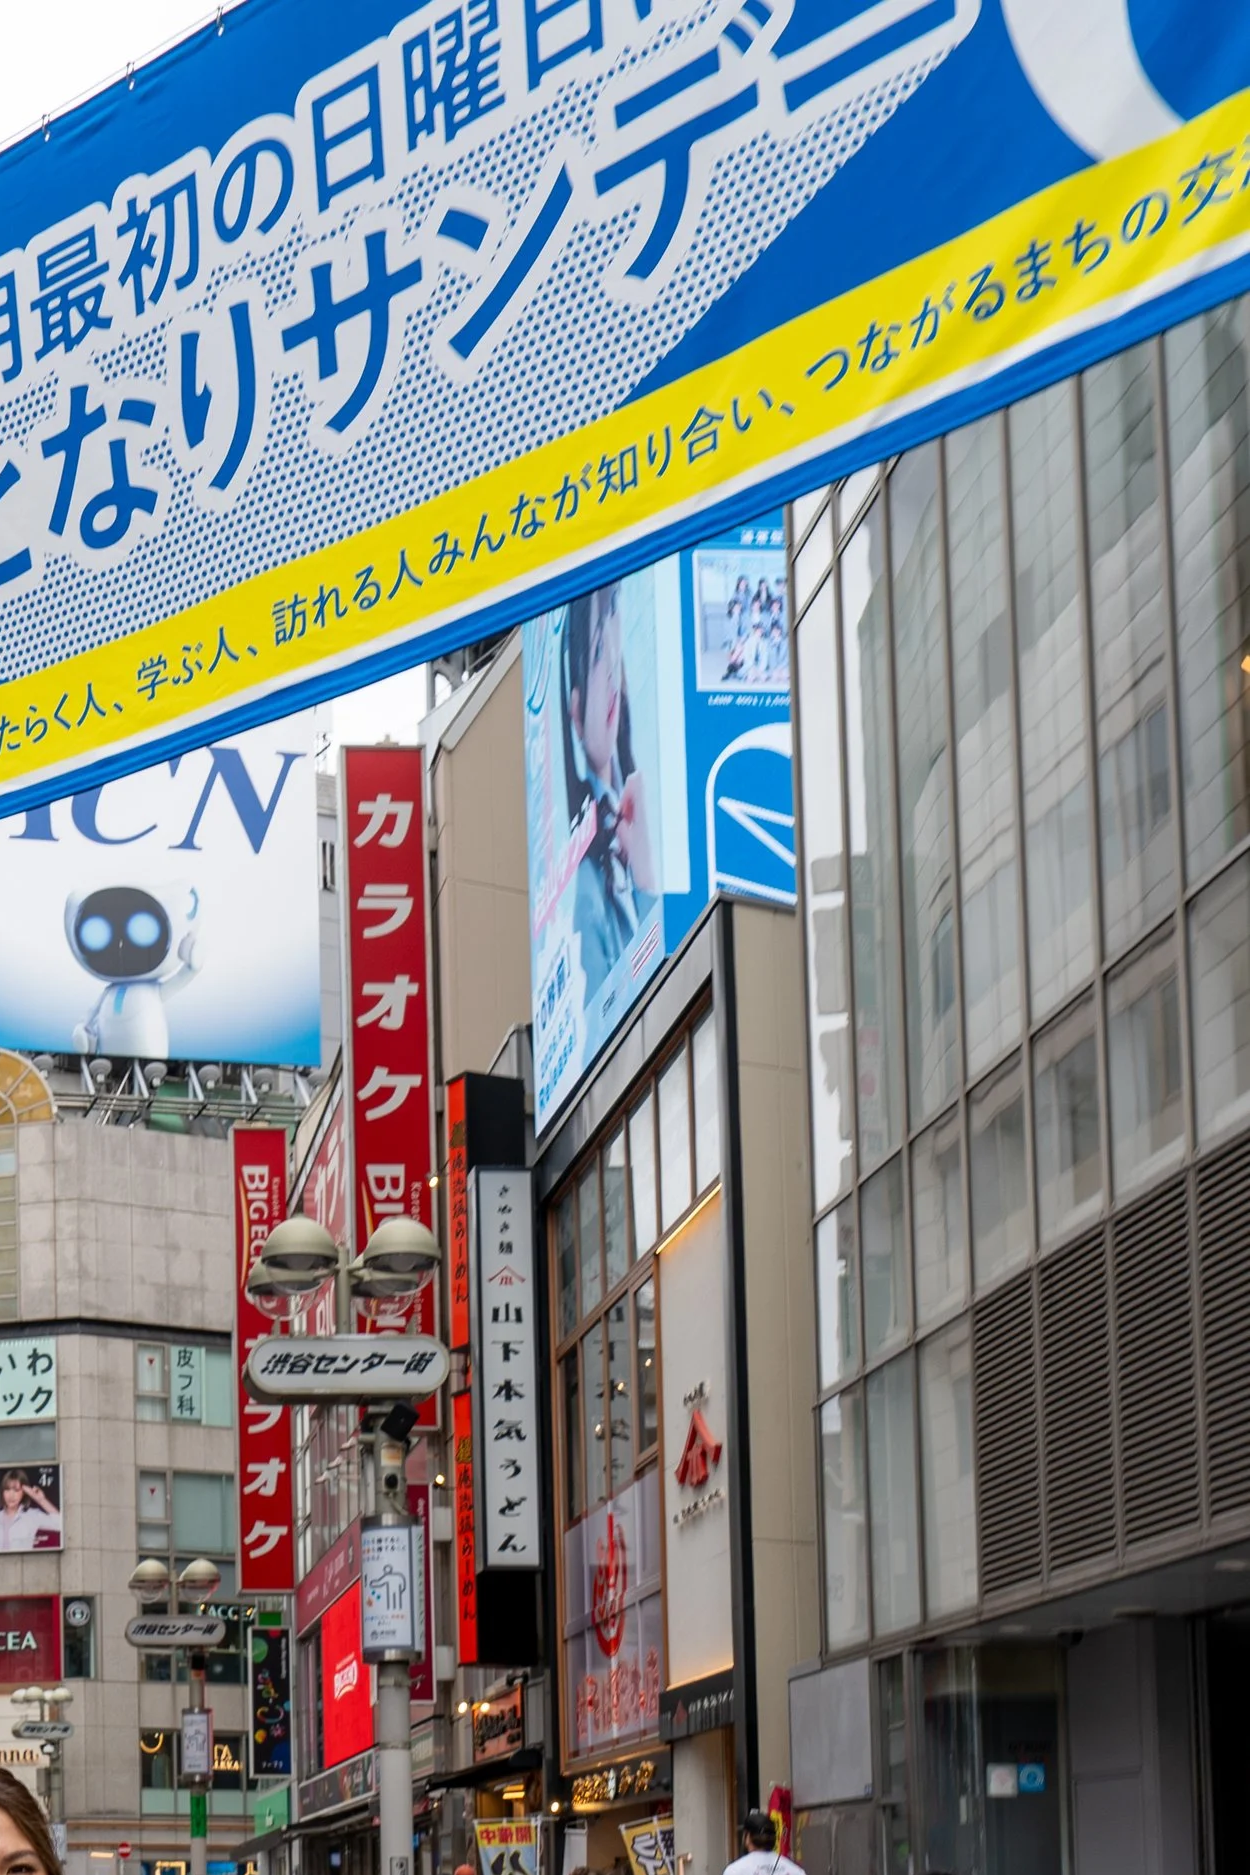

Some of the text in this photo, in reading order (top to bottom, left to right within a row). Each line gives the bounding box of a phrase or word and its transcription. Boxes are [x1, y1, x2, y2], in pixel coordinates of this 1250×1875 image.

[354, 793, 423, 1122] カラオケ
[241, 1165, 269, 1220] BIG
[177, 1348, 195, 1416] 皮フ科
[260, 1352, 436, 1375] 渋谷センター街
[490, 1302, 526, 1553] 山下本気うどん
[243, 1333, 289, 1559] ラオケ
